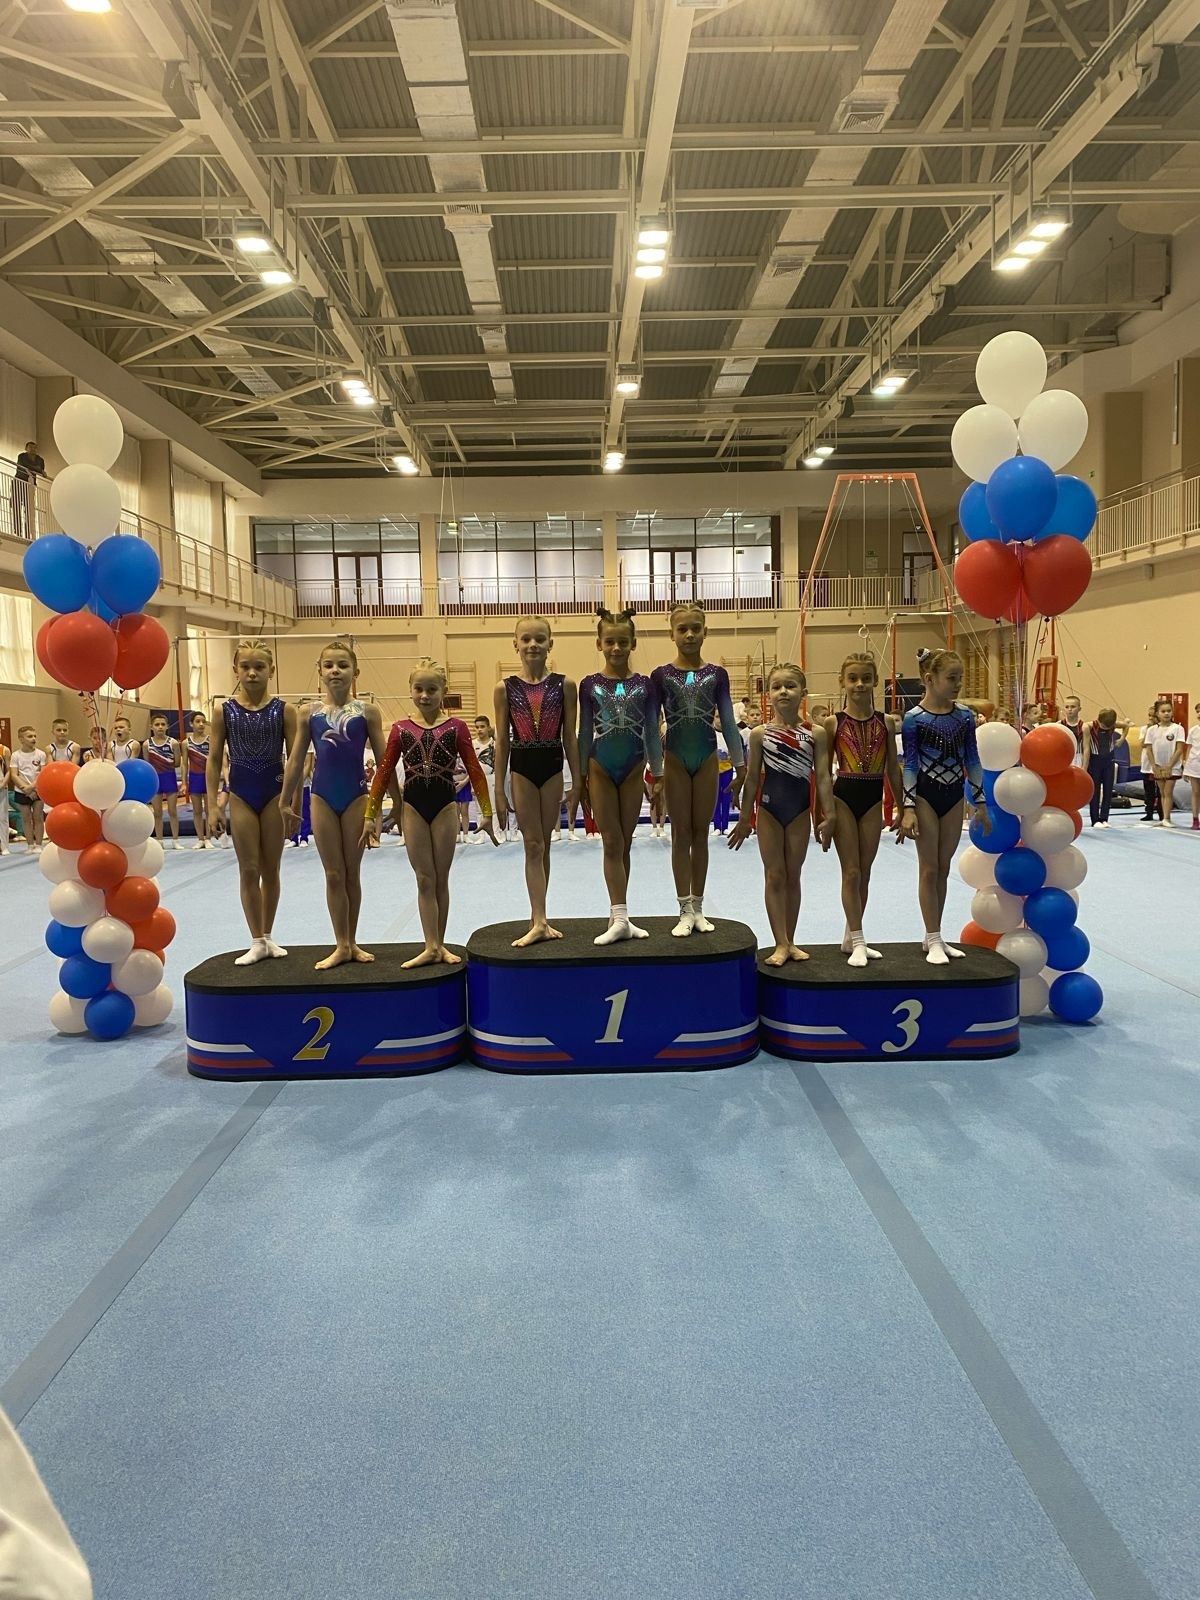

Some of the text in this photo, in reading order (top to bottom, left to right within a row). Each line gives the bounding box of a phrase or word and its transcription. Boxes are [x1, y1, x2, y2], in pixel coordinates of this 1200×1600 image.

[292, 1006, 335, 1060] 2
[595, 989, 629, 1043] 1
[881, 999, 923, 1052] 3
